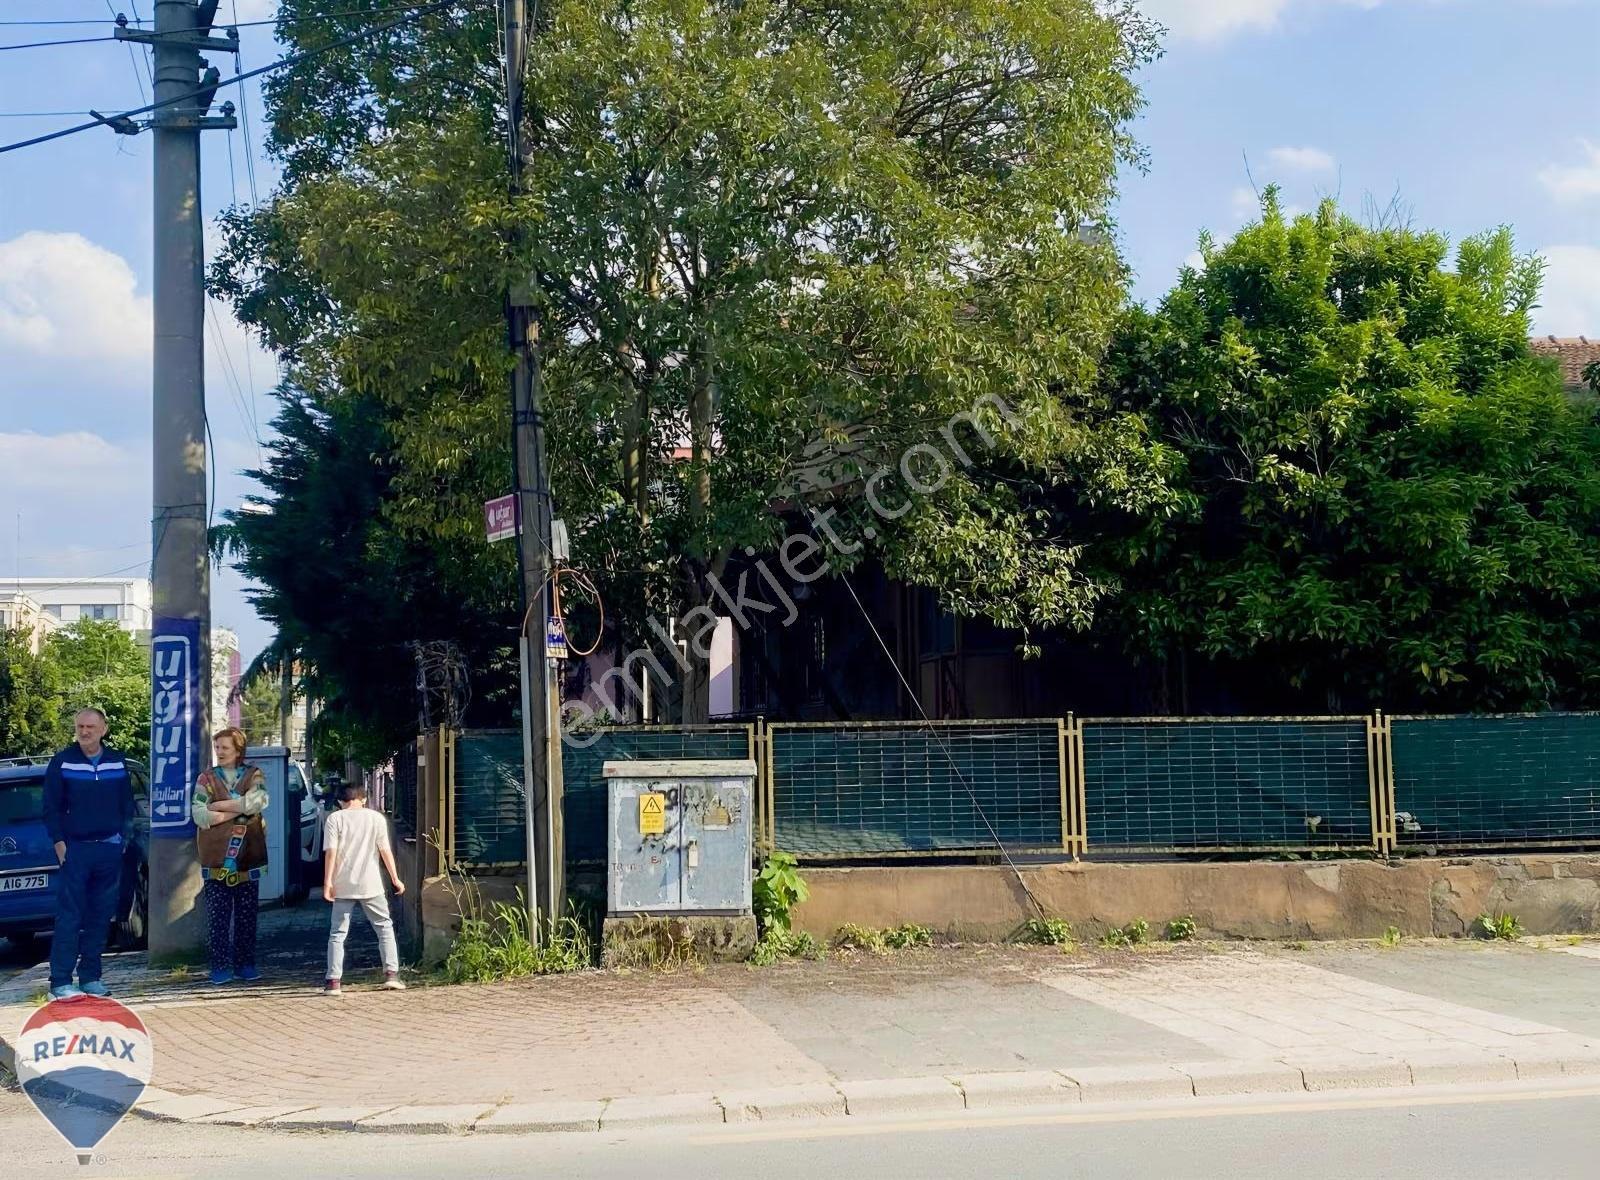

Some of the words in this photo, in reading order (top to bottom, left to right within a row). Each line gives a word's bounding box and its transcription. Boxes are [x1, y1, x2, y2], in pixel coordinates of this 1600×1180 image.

[154, 650, 182, 784] uğur
[3, 878, 22, 890] AIG
[25, 876, 45, 888] 775
